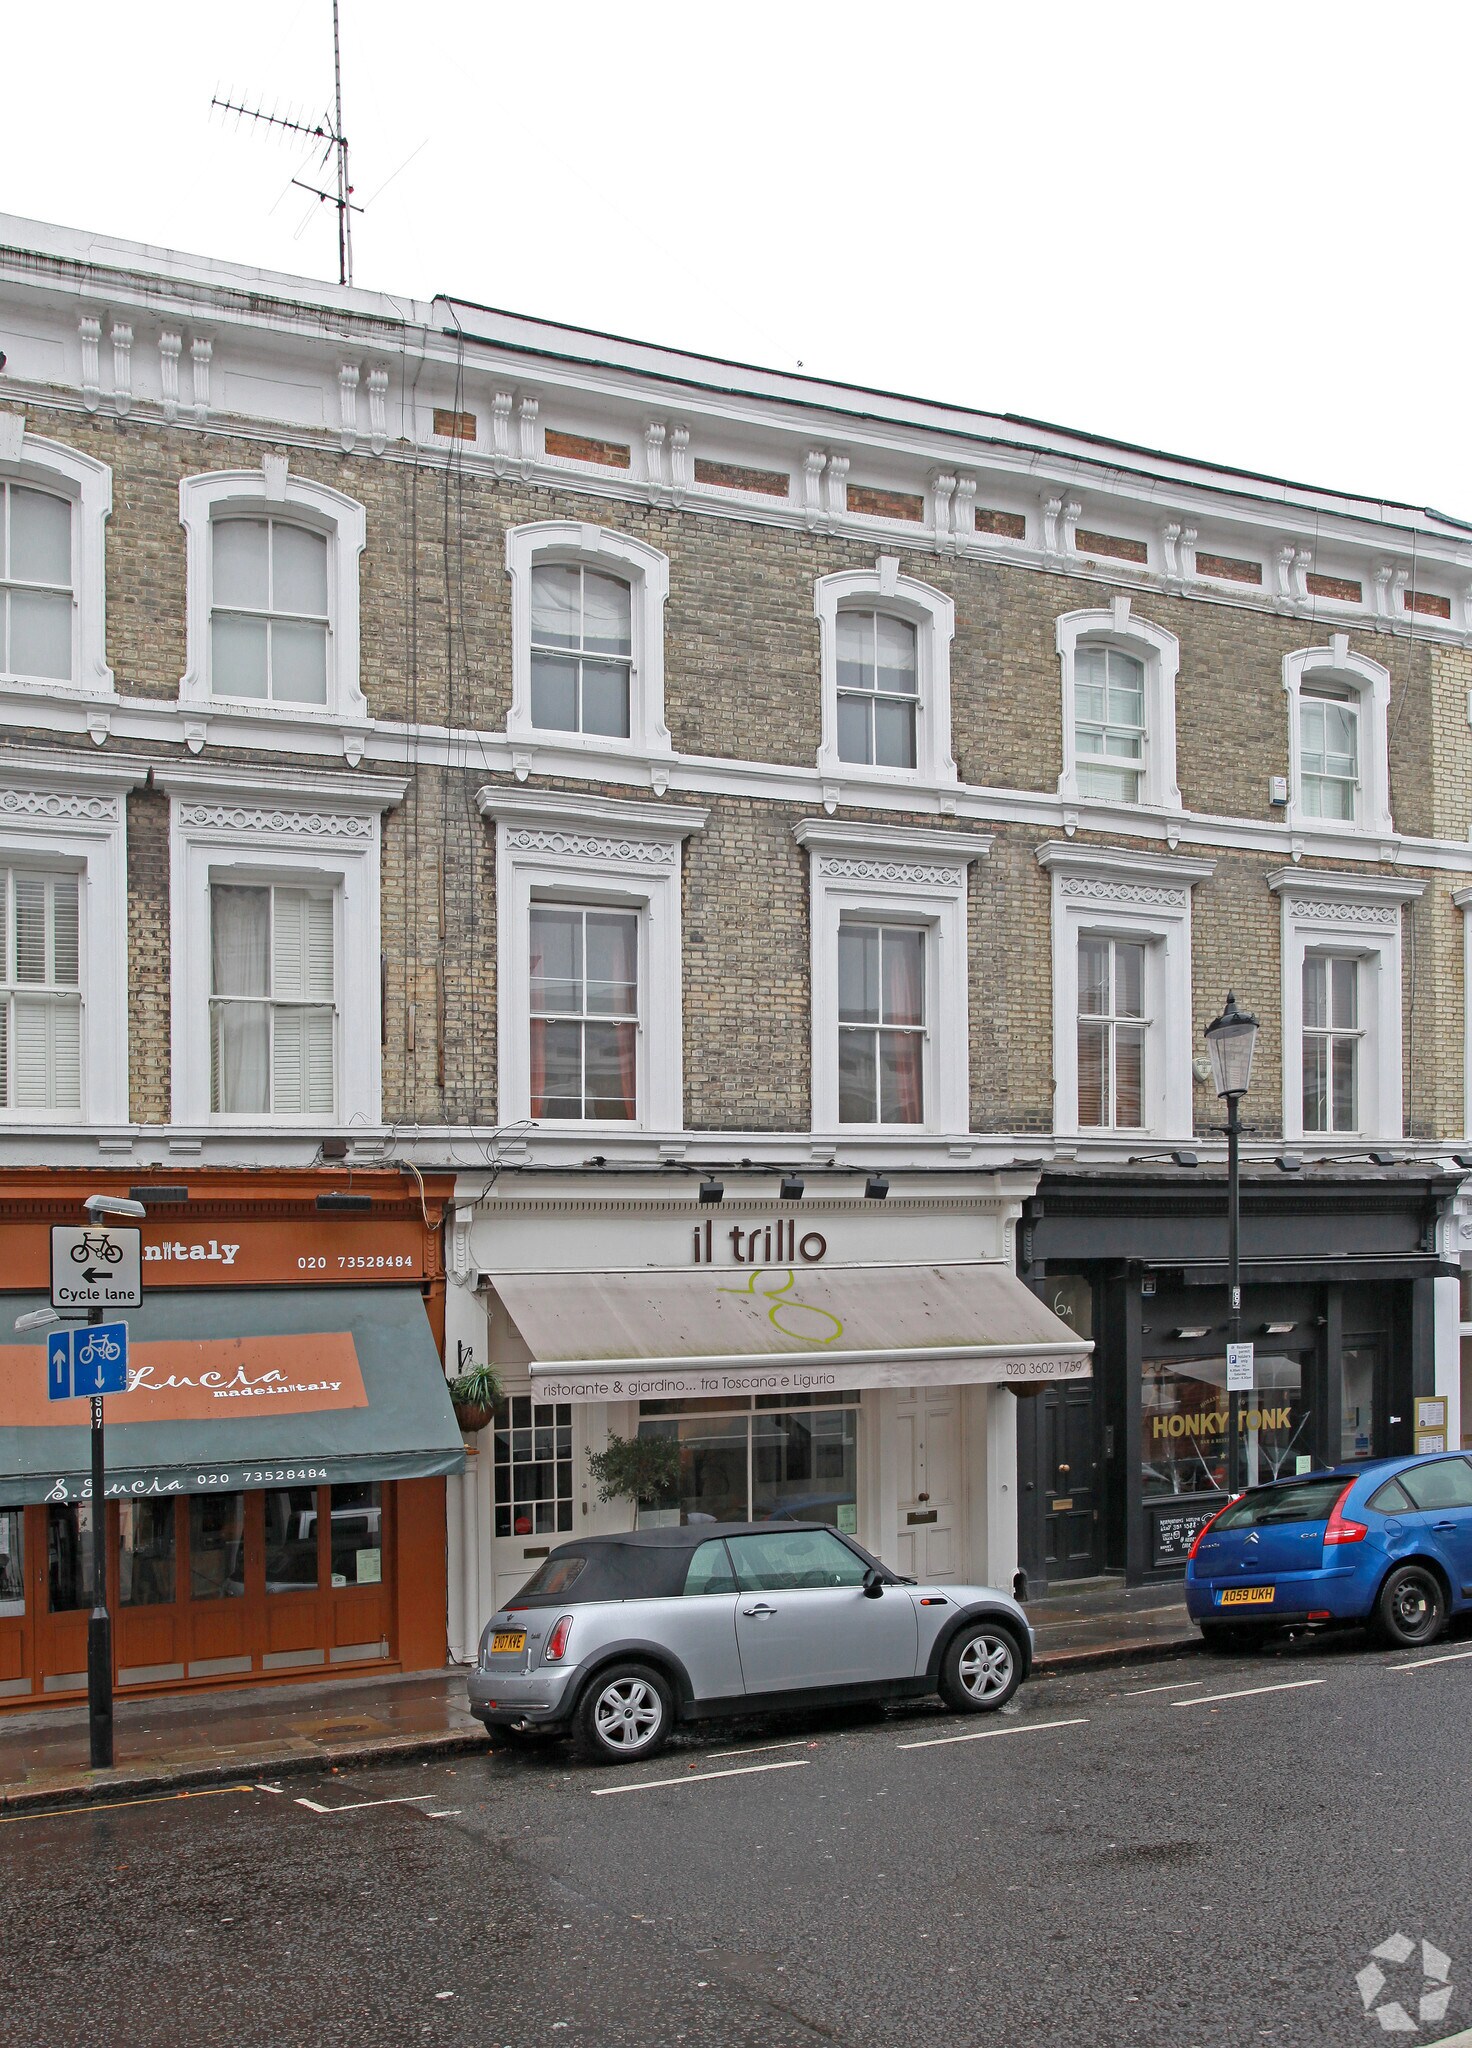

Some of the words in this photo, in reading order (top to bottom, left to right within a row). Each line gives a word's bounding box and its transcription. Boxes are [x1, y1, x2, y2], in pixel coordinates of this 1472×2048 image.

[694, 1219, 712, 1262] il
[729, 1219, 827, 1262] trillo
[297, 1257, 327, 1269] 020
[337, 1255, 413, 1268] 73528484
[59, 1287, 100, 1301] Cycle
[105, 1287, 135, 1300] lane
[1054, 1290, 1073, 1316] 6A
[1005, 1363, 1026, 1375] 020
[1028, 1361, 1055, 1374] 3602
[1058, 1360, 1082, 1373] 1759
[127, 1365, 288, 1393] Lucia
[543, 1382, 609, 1396] ristorante
[613, 1380, 624, 1393] &
[700, 1378, 719, 1390] tra
[722, 1376, 777, 1389] Toscana
[780, 1376, 790, 1387] e
[793, 1372, 835, 1389] Liguria
[1153, 1411, 1229, 1439] HONKY
[1238, 1407, 1292, 1433] TONK
[197, 1473, 230, 1485] 020
[243, 1468, 328, 1482] 73528484
[1251, 1588, 1273, 1600] UKH
